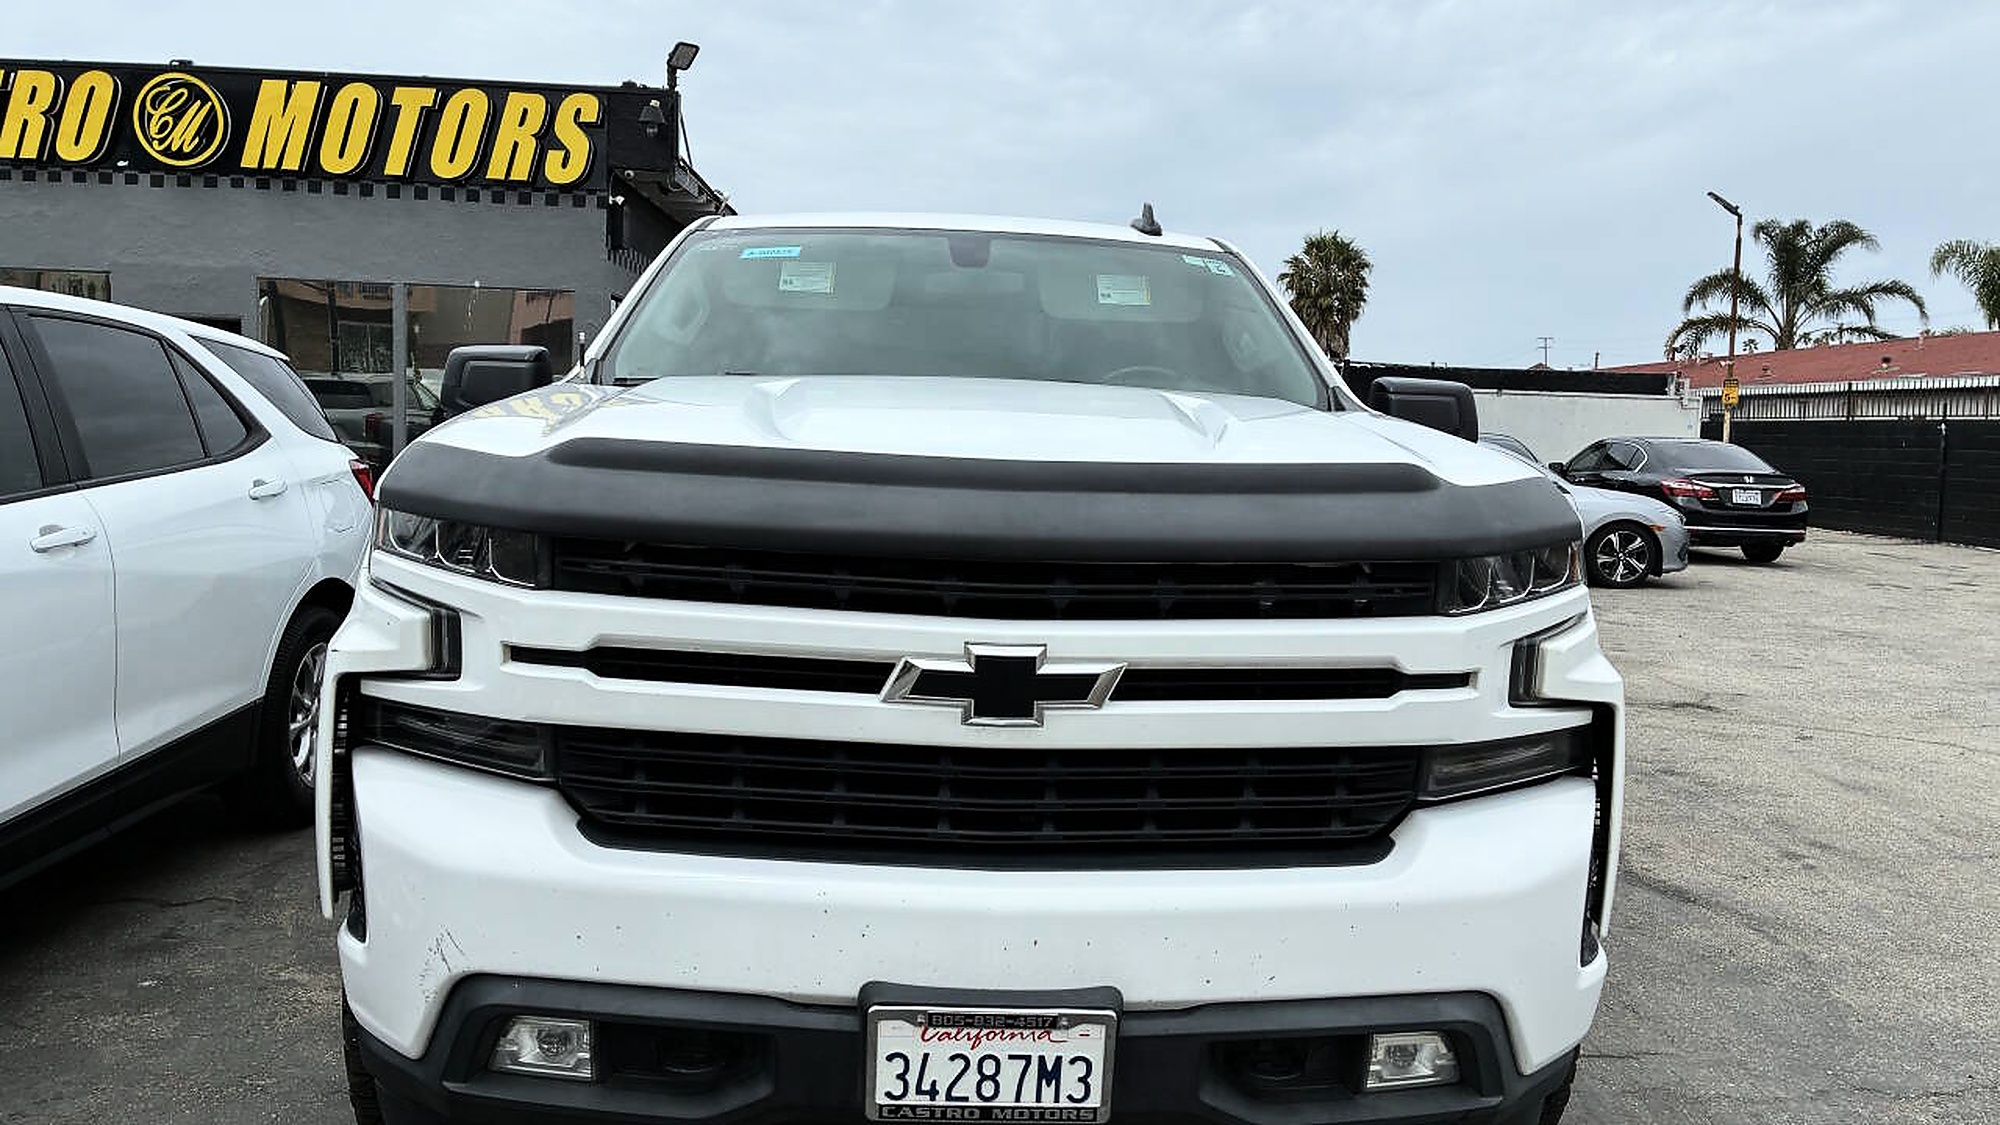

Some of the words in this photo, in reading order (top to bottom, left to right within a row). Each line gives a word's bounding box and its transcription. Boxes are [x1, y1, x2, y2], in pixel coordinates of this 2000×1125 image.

[0, 68, 115, 162] RO
[240, 78, 600, 184] MOTORS
[920, 1026, 1068, 1050] California
[883, 1052, 1094, 1104] 34287M3
[881, 1106, 981, 1120] CASTRO
[992, 1107, 1095, 1121] MOTORS
